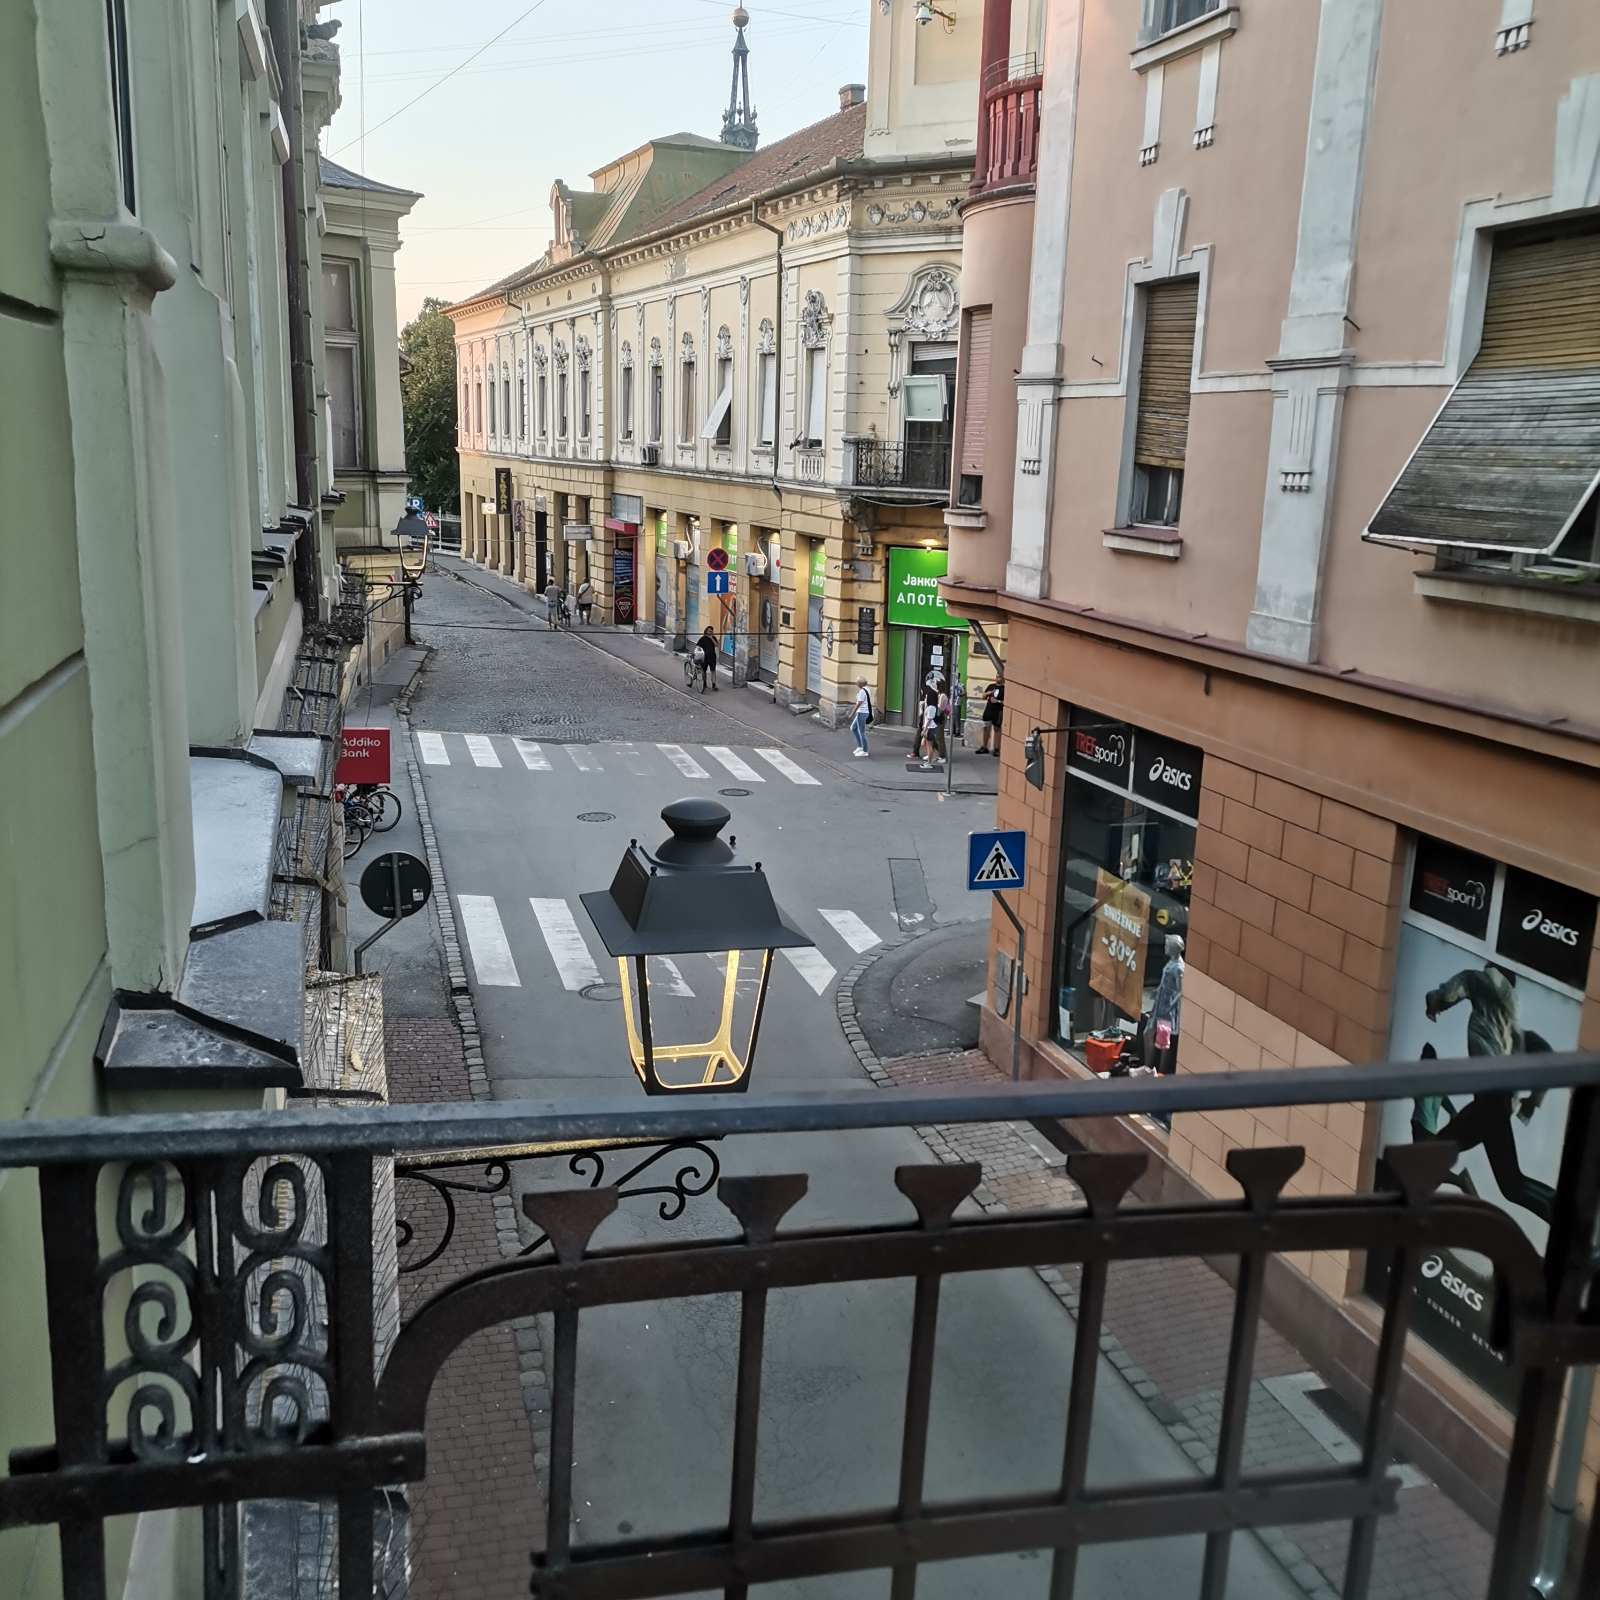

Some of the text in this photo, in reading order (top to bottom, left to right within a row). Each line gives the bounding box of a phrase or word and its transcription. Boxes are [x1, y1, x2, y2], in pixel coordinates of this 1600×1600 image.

[1162, 765, 1192, 791] asics
[1539, 918, 1580, 947] asics
[1440, 1269, 1484, 1312] asics
